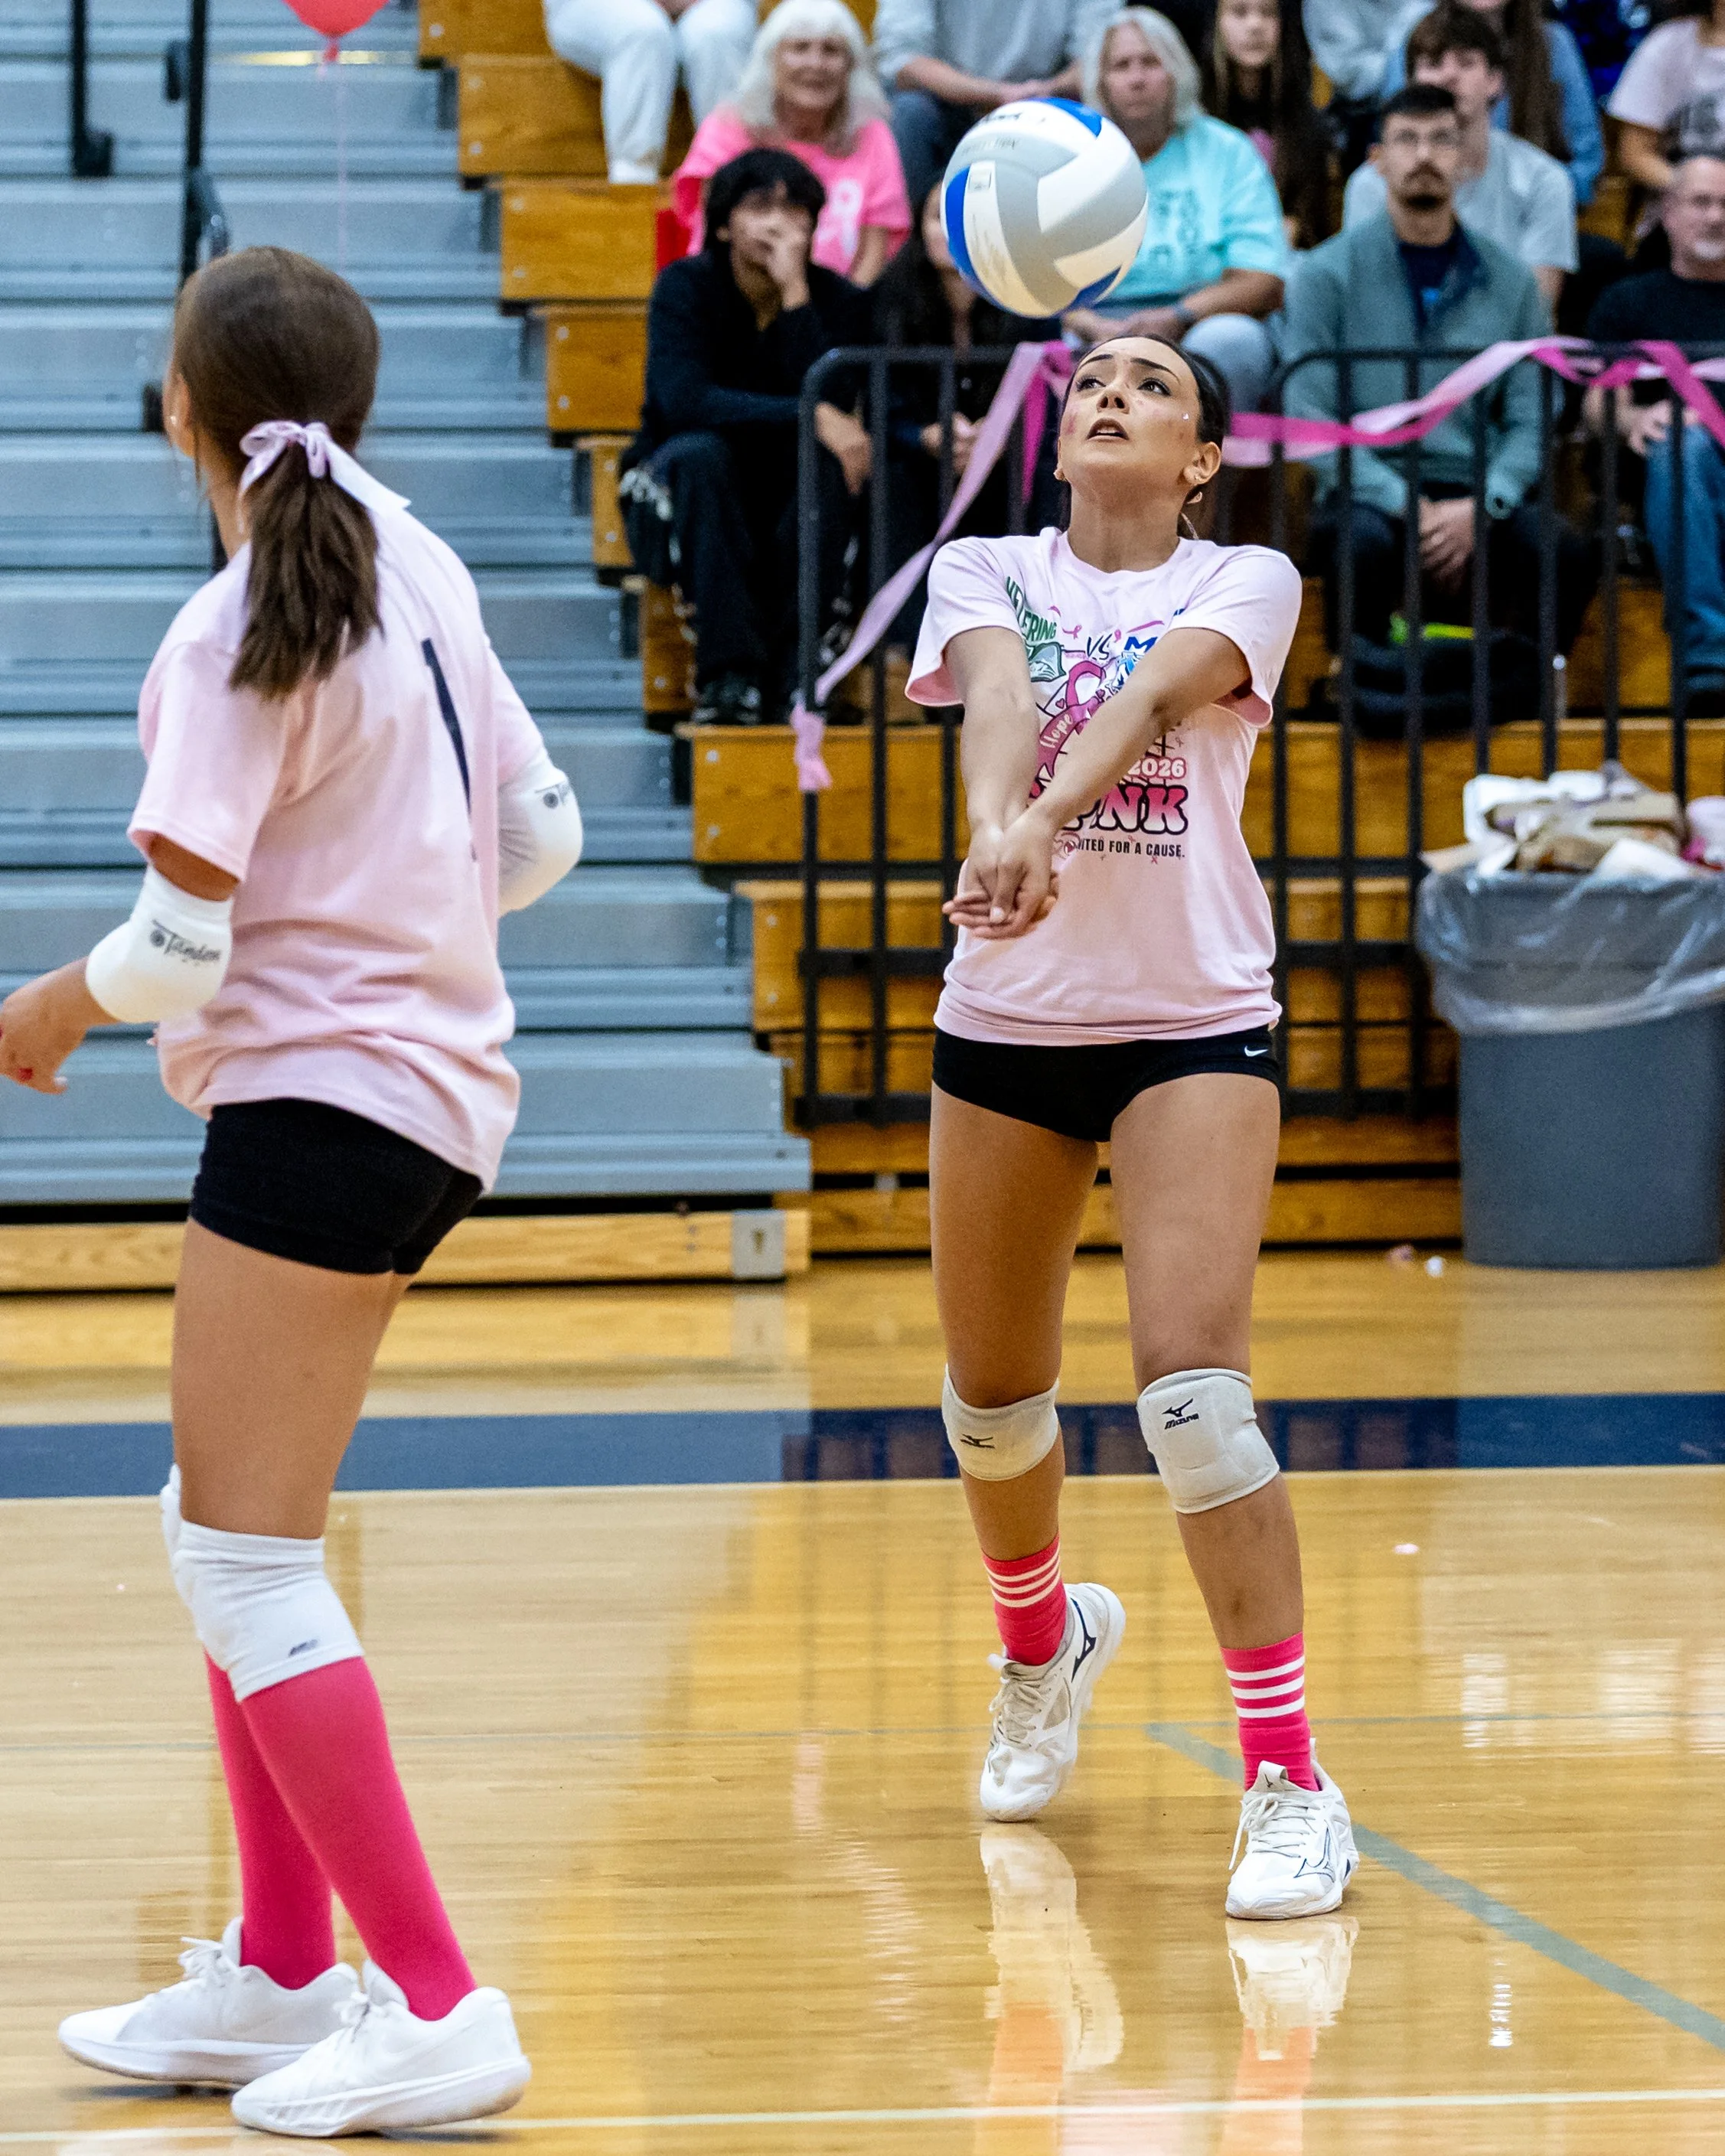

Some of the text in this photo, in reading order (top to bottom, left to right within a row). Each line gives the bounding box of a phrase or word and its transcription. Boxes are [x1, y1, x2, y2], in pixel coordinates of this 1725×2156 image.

[1039, 713, 1072, 749] Hope
[1110, 840, 1130, 854] FOR
[1134, 842, 1142, 855] A
[1146, 843, 1185, 858] CAUSE.
